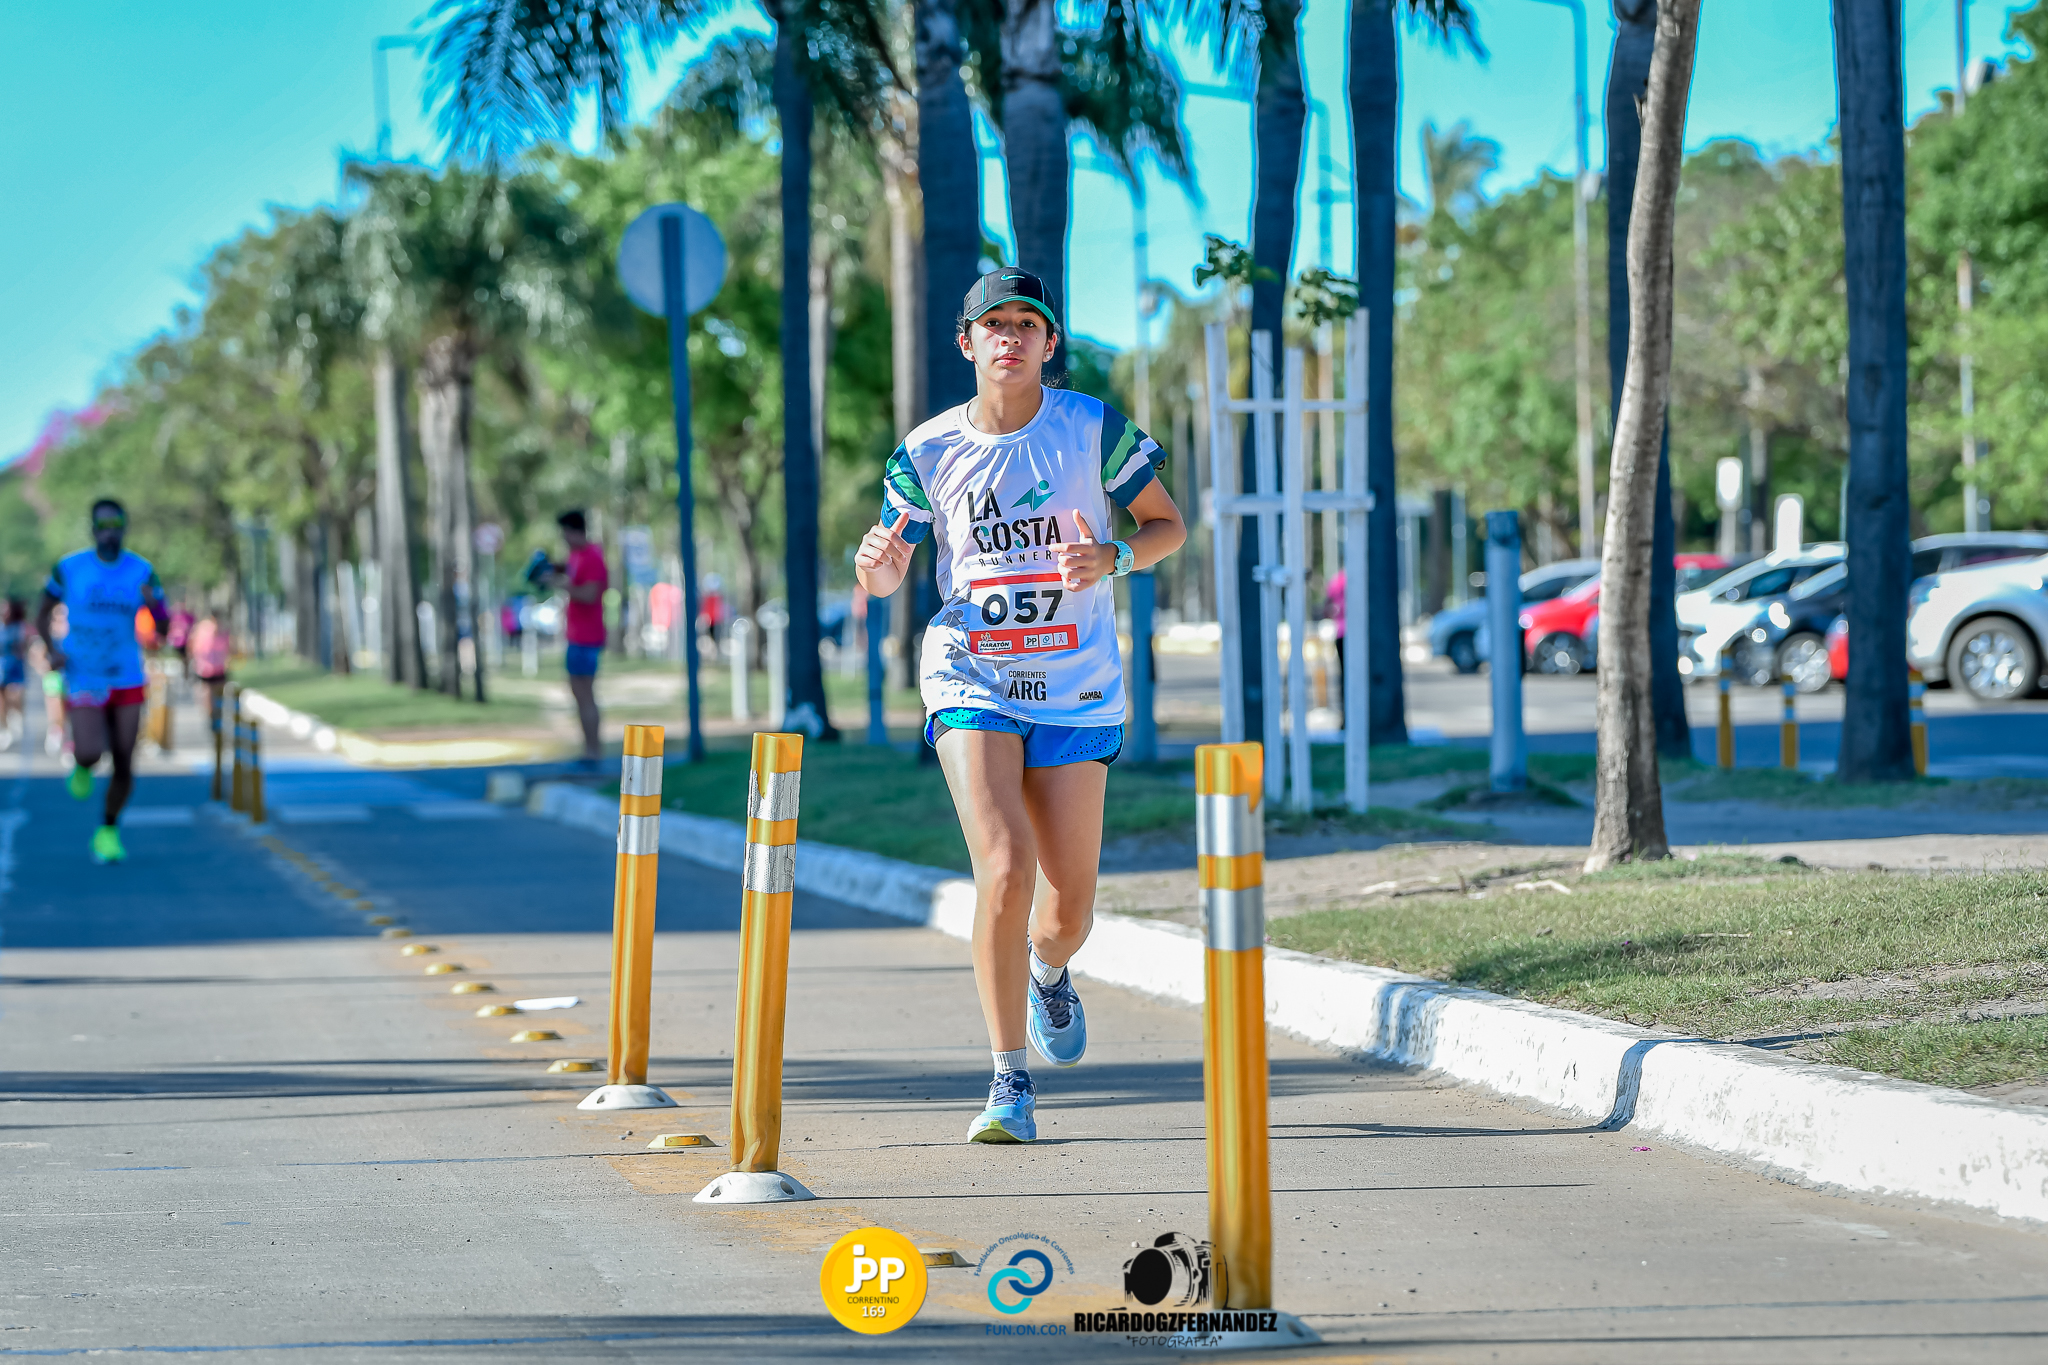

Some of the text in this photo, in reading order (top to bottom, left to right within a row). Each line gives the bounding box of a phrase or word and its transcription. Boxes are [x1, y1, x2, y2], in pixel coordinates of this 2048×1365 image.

[967, 488, 1002, 522] LA
[972, 516, 1062, 553] COSTA
[979, 550, 1061, 567] RUNNER
[981, 589, 1063, 625] 057
[1008, 670, 1047, 679] CORRIENTES
[1007, 680, 1047, 701] ARG
[1079, 690, 1103, 701] GAMBA
